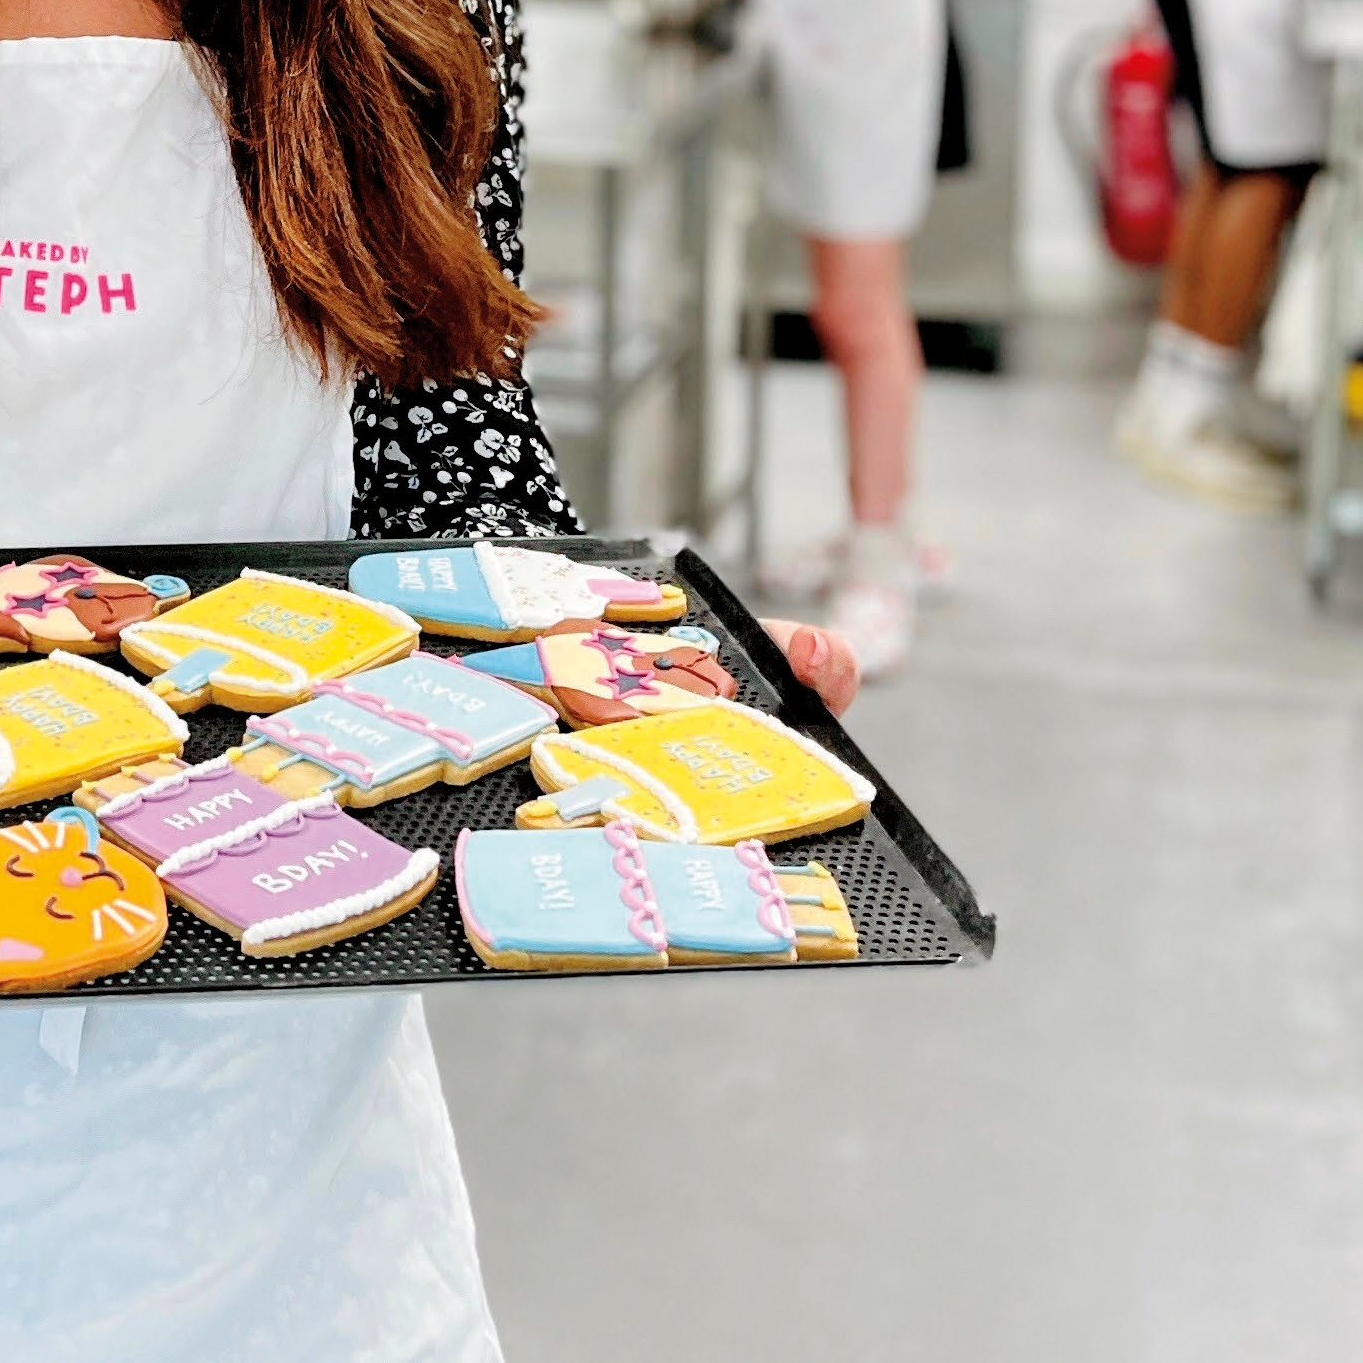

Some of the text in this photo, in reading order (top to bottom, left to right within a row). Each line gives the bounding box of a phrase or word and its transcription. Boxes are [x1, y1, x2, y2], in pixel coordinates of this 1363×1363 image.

[69, 245, 89, 264] BY
[163, 788, 254, 831] HAPPY
[251, 839, 369, 894] BDAY!
[530, 852, 575, 910] BDAY!
